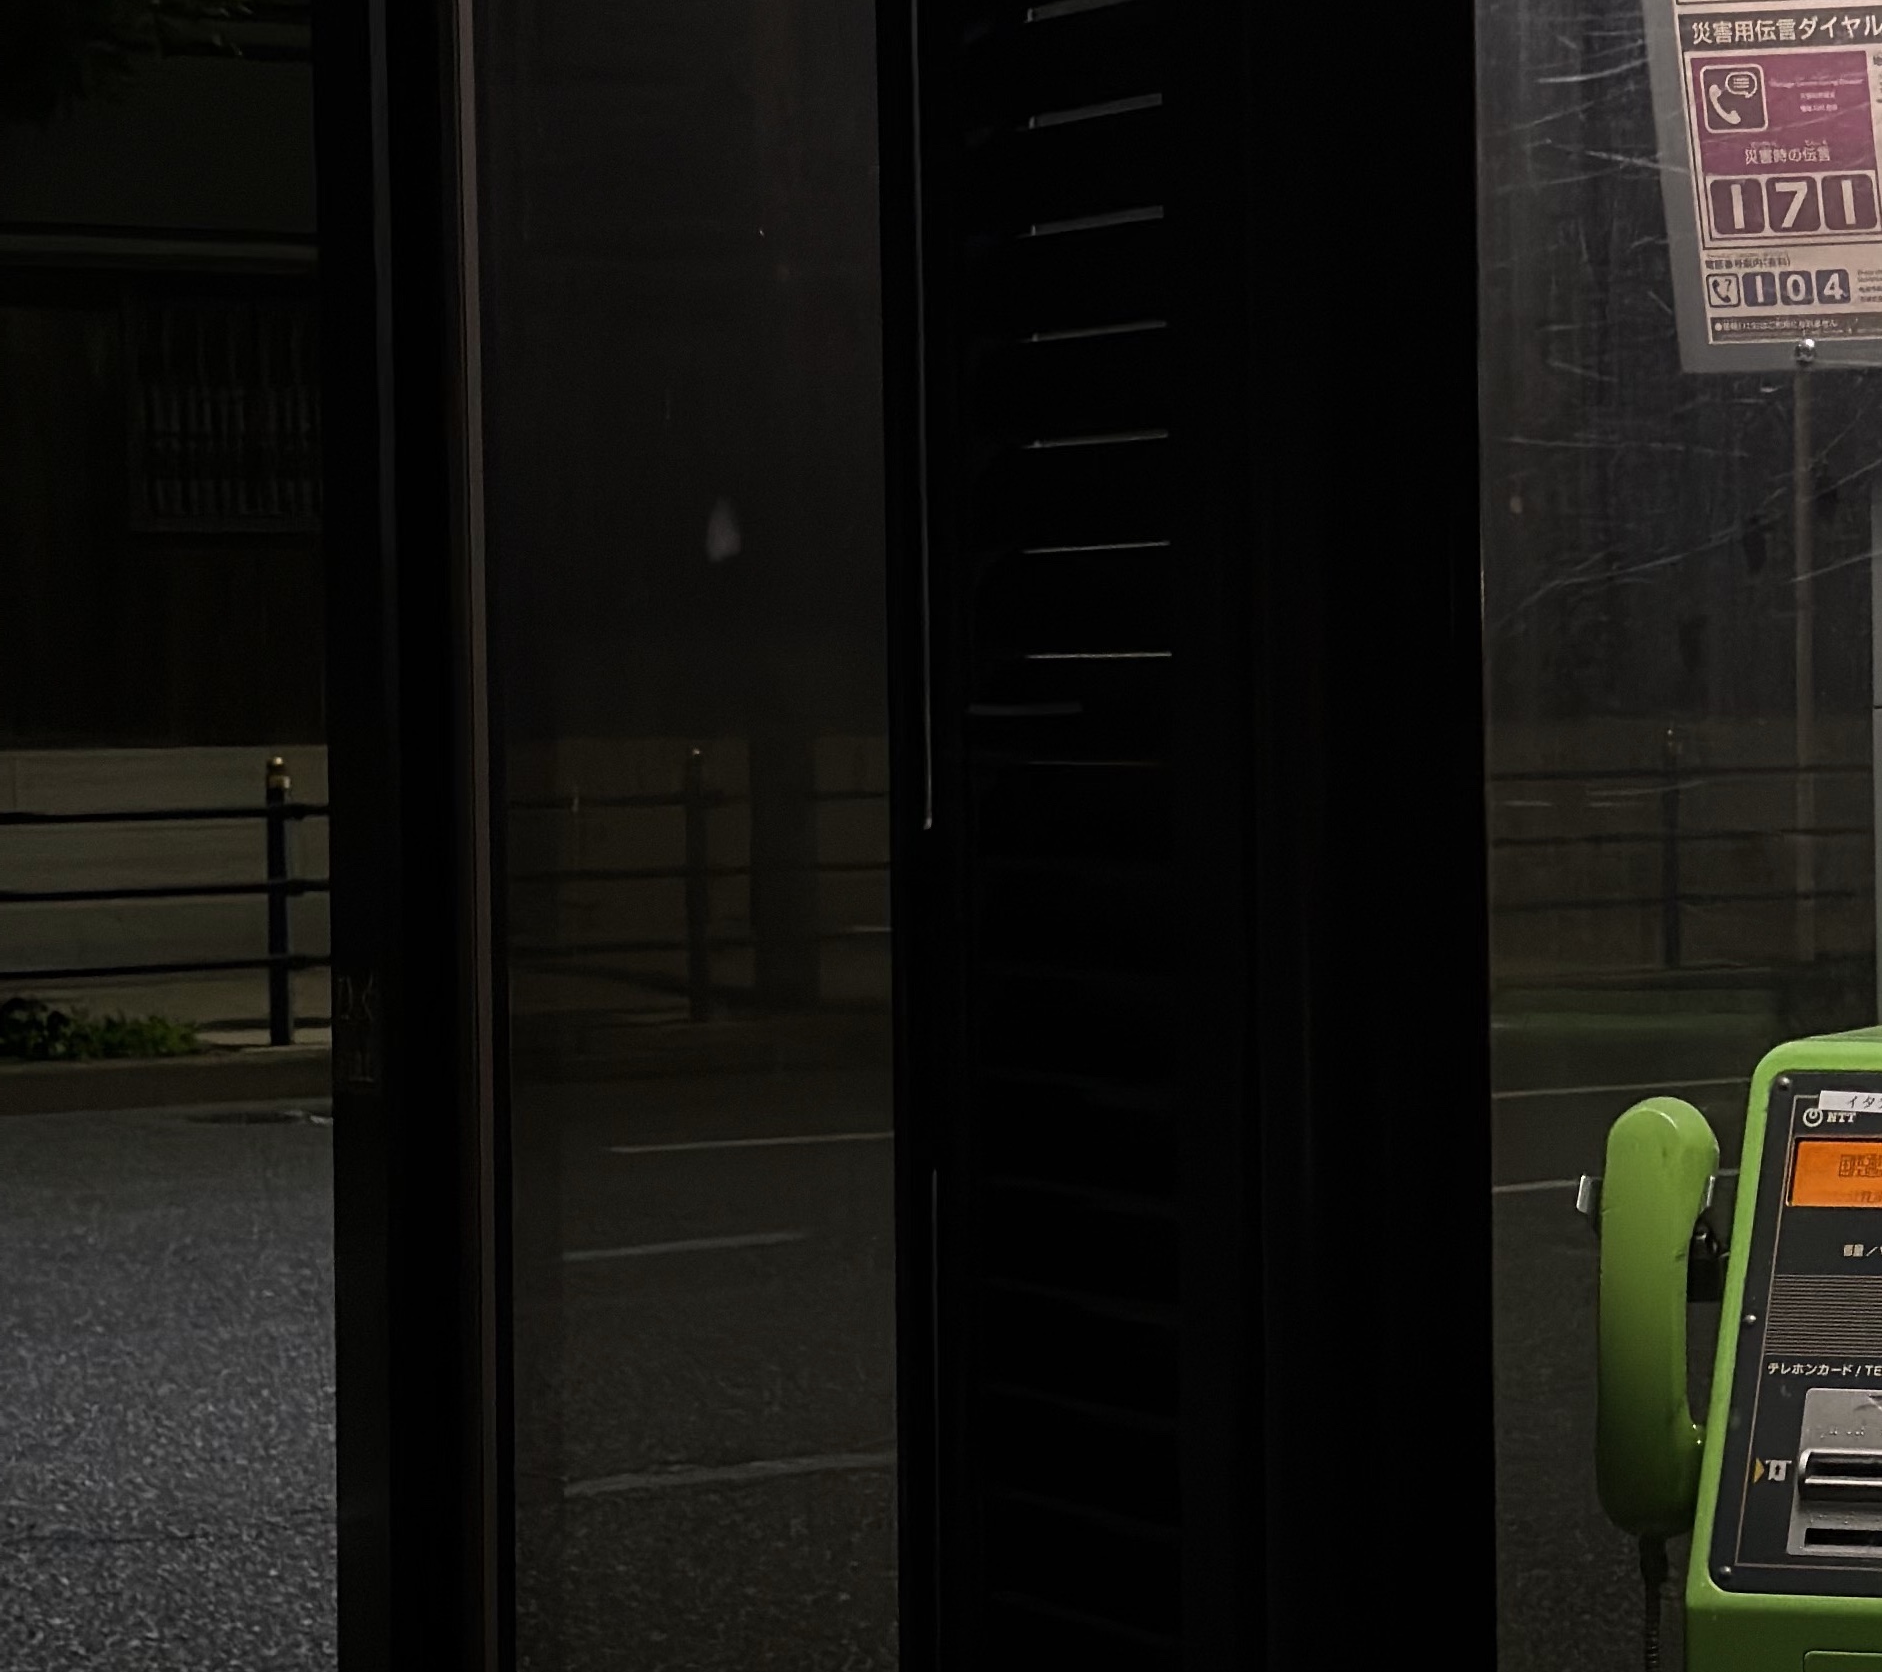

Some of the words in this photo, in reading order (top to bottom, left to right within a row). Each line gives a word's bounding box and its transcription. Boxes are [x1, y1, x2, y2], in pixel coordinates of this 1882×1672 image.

[1731, 180, 1856, 230] 171
[1755, 273, 1846, 303] 104
[1827, 1112, 1857, 1123] NTT
[1768, 1362, 1853, 1377] テレホンカード
